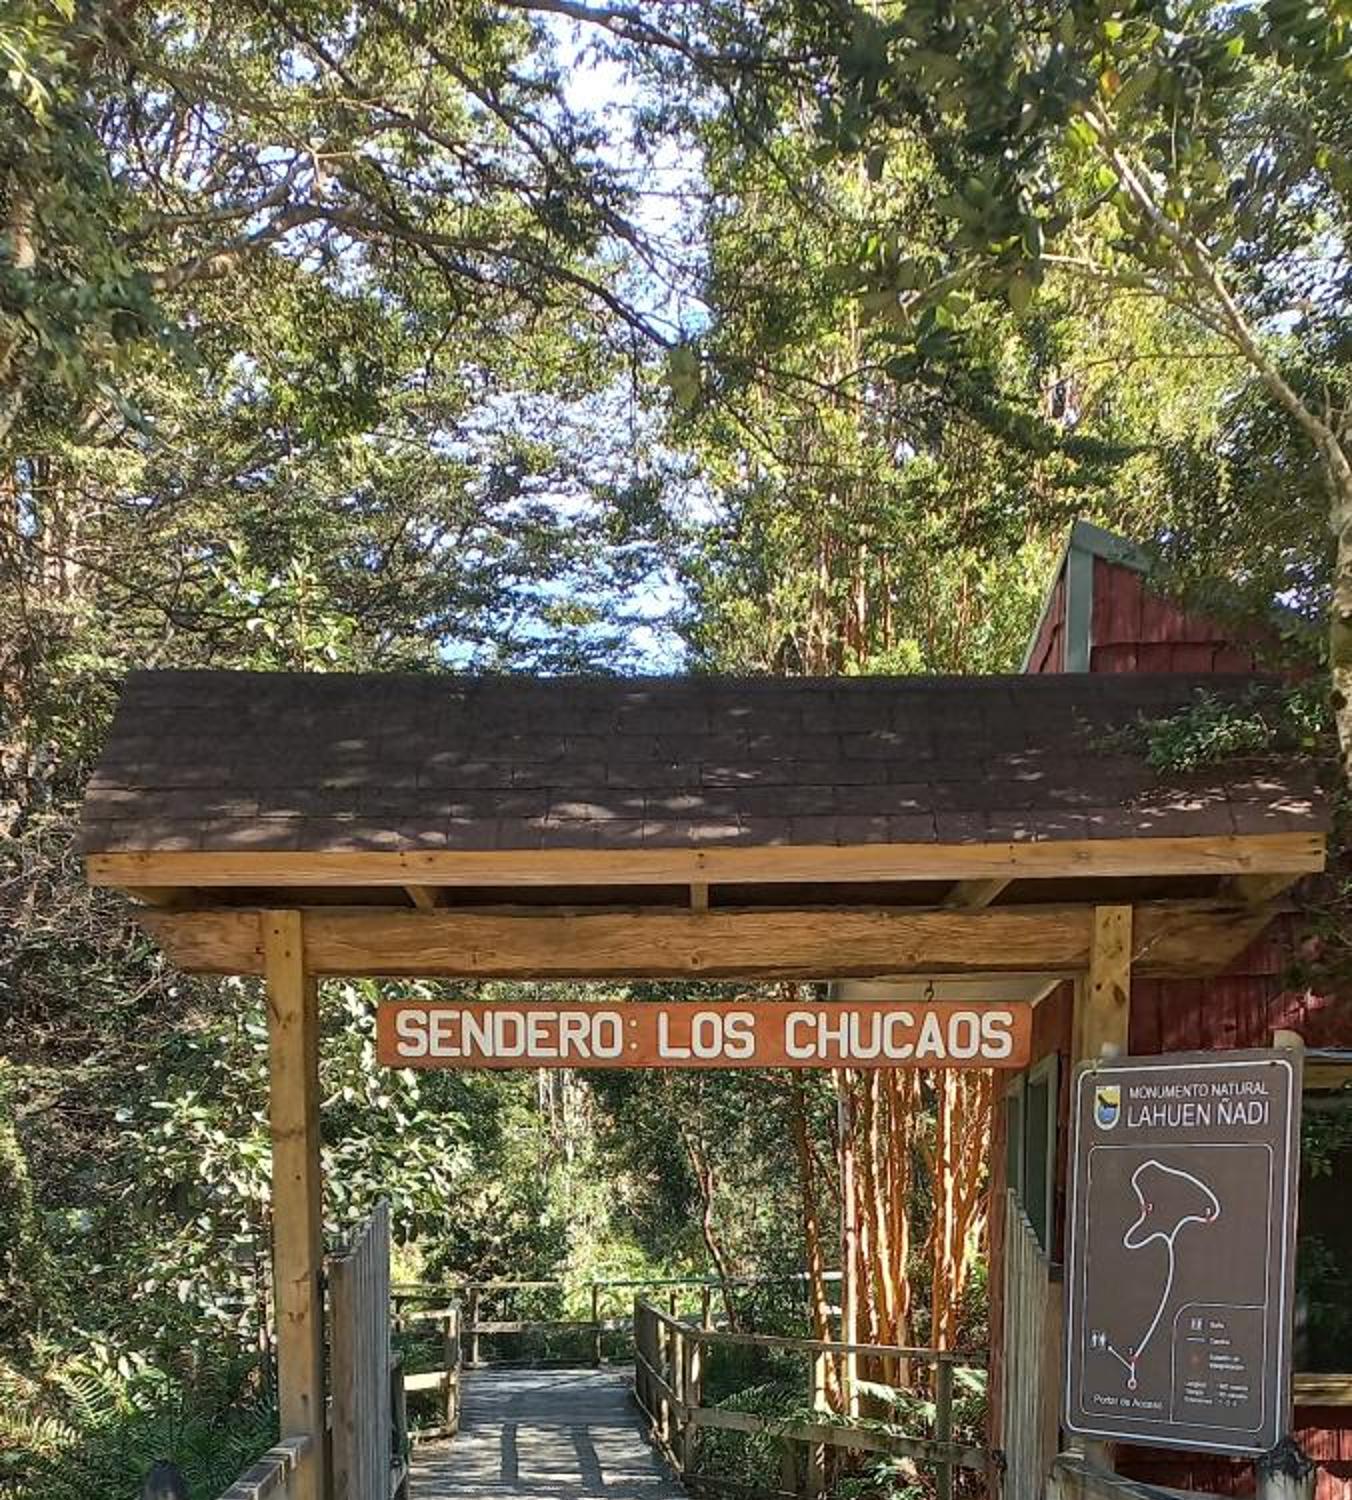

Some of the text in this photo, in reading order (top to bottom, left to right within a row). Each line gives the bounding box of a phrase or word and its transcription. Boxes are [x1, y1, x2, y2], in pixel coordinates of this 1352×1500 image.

[657, 1010, 756, 1059] LOS
[785, 1010, 1013, 1059] CHUCAOS
[1129, 1082, 1269, 1099] MONUMENTO NATURAL
[1127, 1097, 1269, 1127] LAHUEN ÑADI
